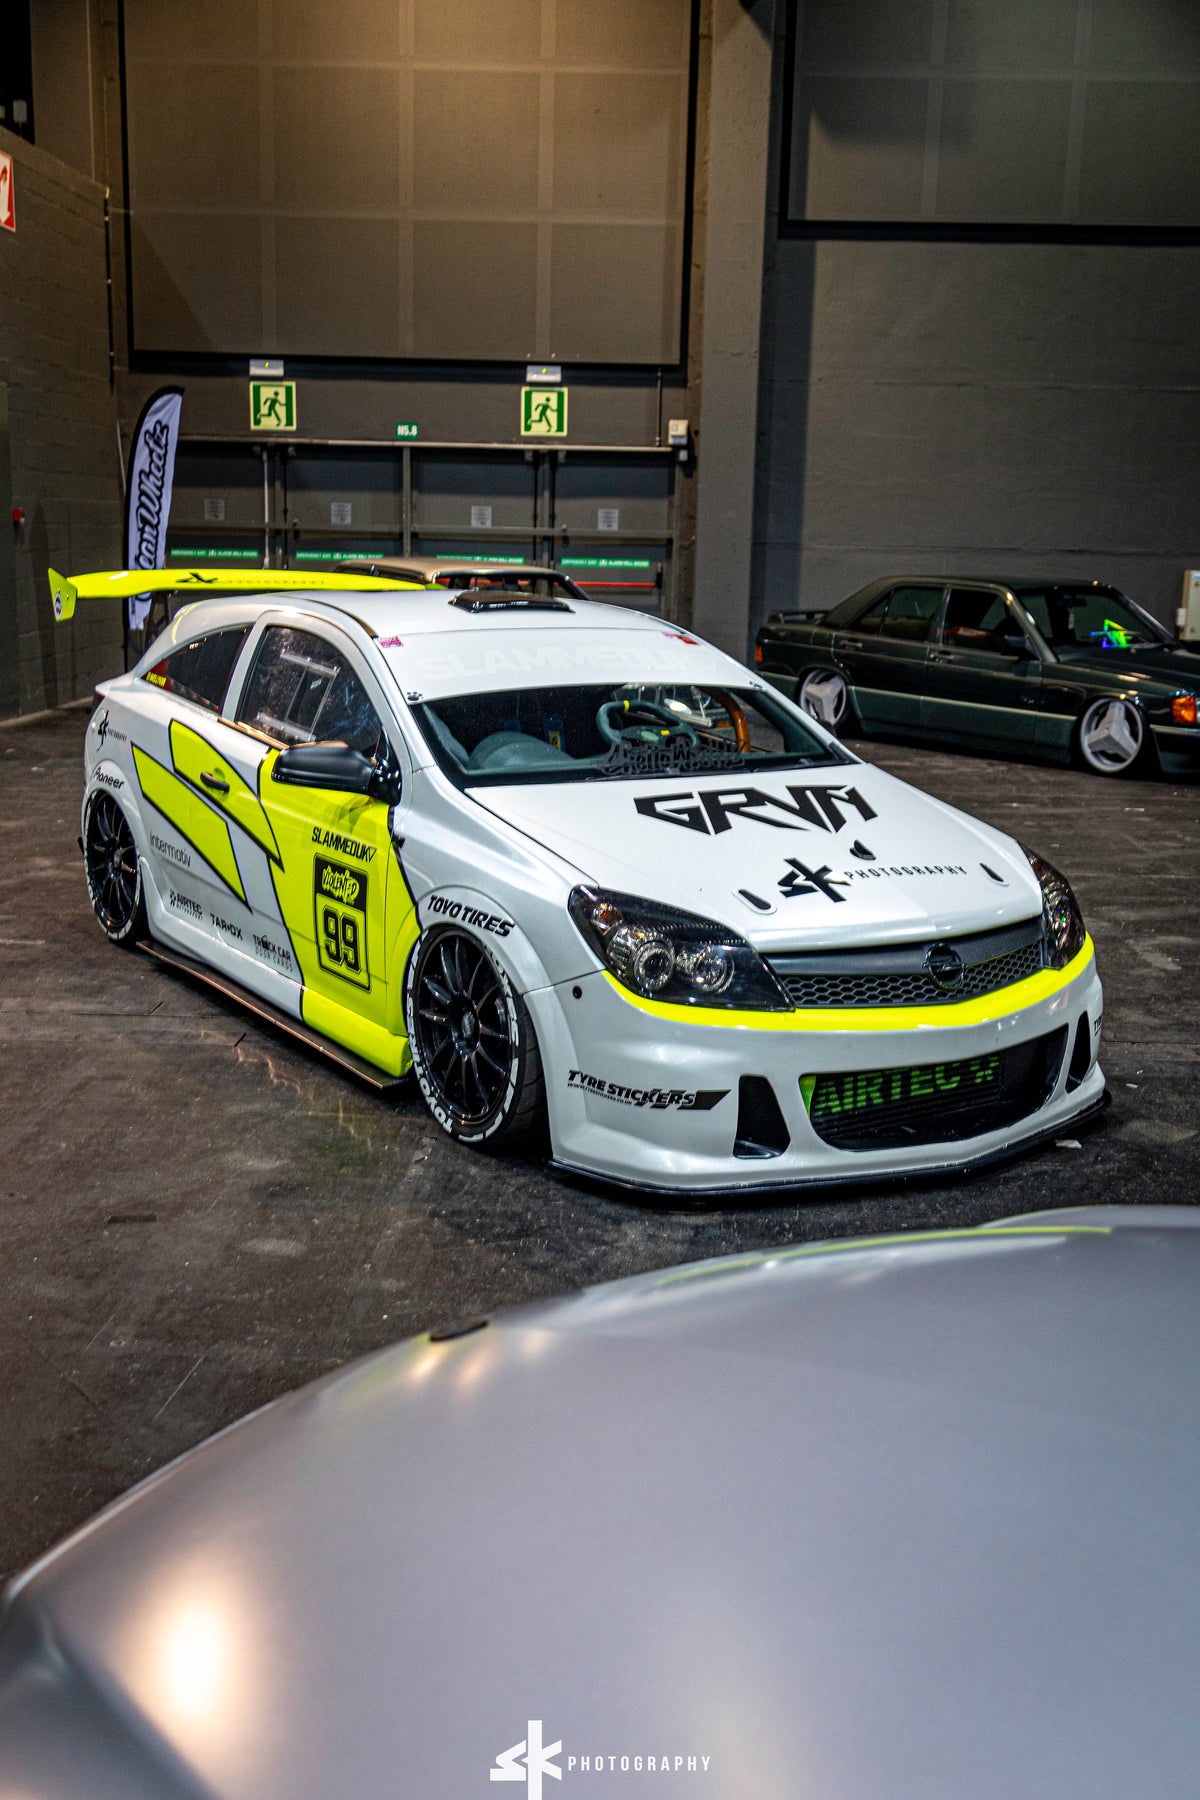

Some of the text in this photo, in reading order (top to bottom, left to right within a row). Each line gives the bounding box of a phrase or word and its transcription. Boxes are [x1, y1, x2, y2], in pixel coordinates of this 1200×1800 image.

[93, 766, 125, 789] Pioneer
[844, 865, 968, 880] PHOTOGRAPHY
[428, 895, 516, 937] TOYO TIRES
[253, 934, 277, 954] TRCK
[323, 905, 361, 975] 99
[568, 1069, 697, 1109] TYRE STICKERS
[814, 1062, 962, 1118] AIRTEC
